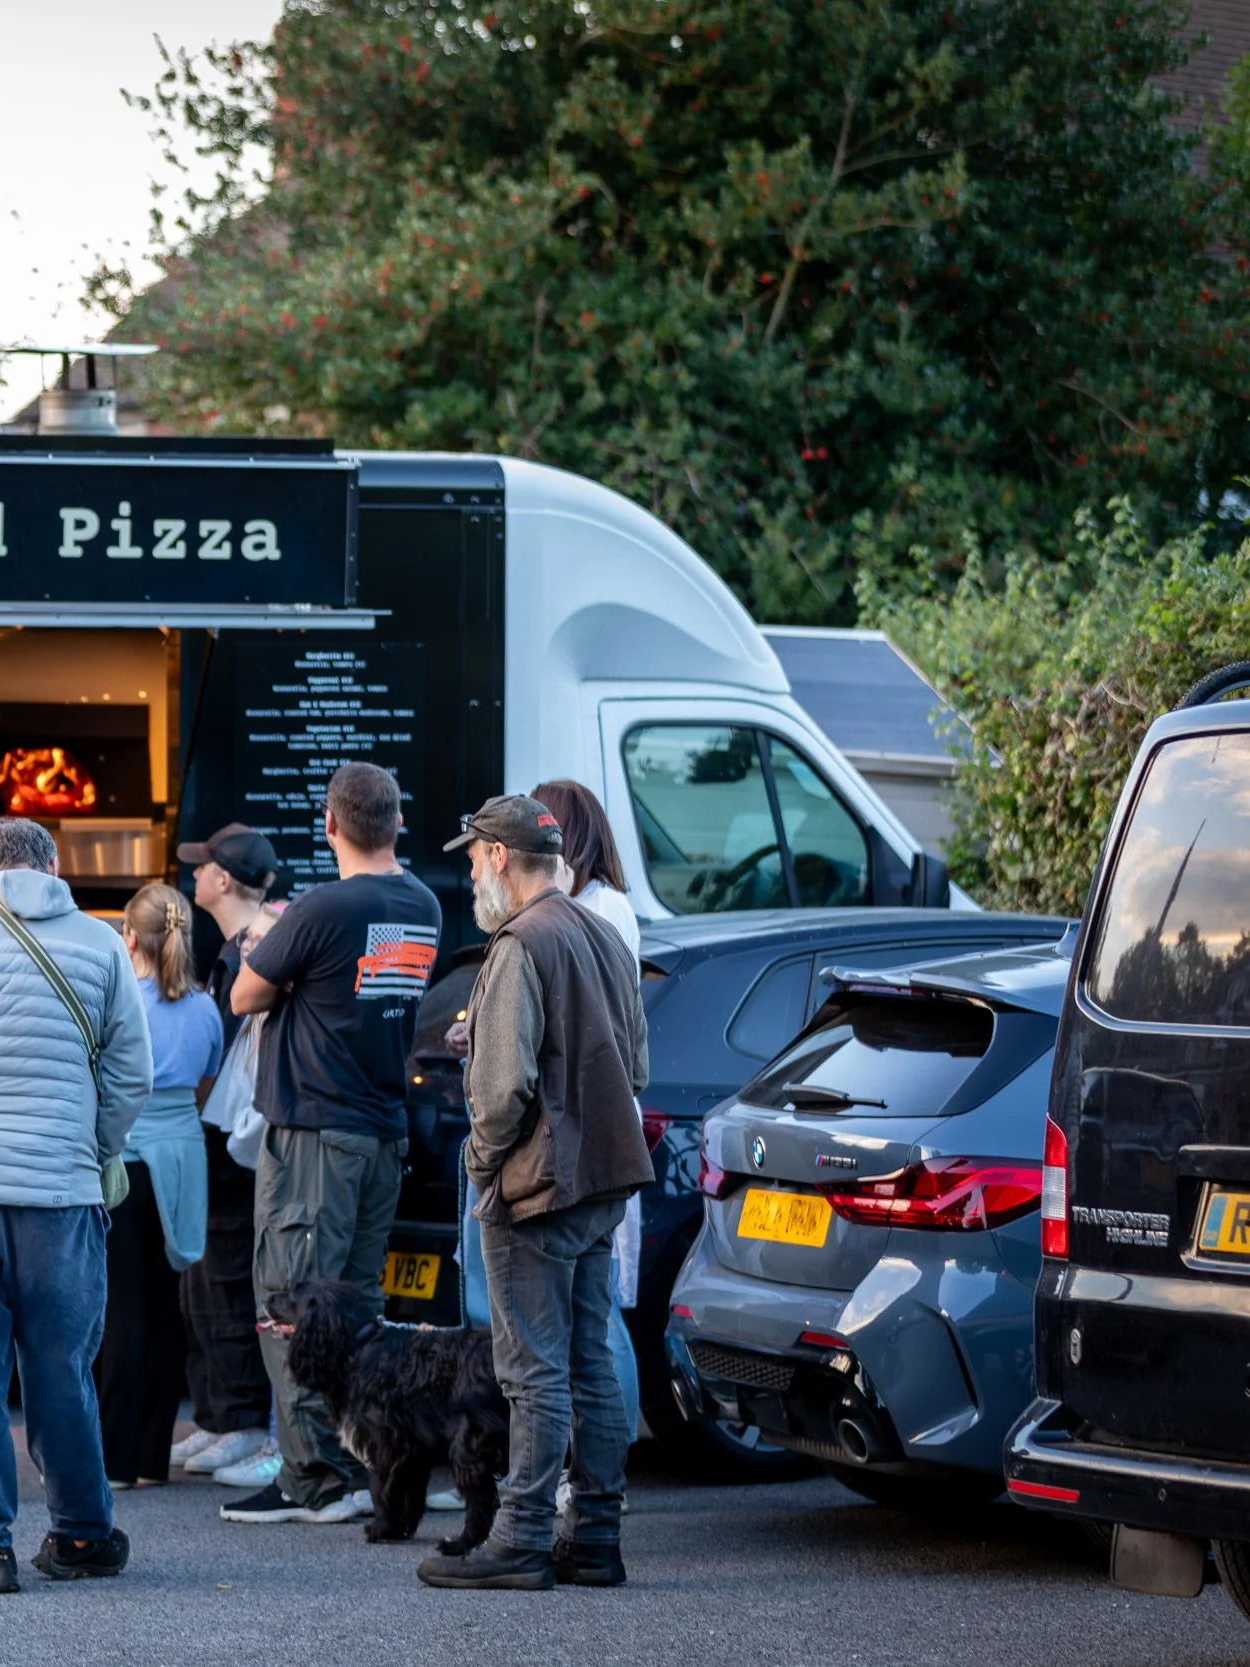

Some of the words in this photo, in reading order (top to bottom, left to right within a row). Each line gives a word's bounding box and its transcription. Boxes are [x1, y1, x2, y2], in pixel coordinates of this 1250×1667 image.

[59, 501, 281, 561] Pizza
[1072, 1206, 1170, 1231] TRANSPORTER
[1105, 1227, 1168, 1247] HIGHLINE
[393, 1257, 430, 1291] VBC
